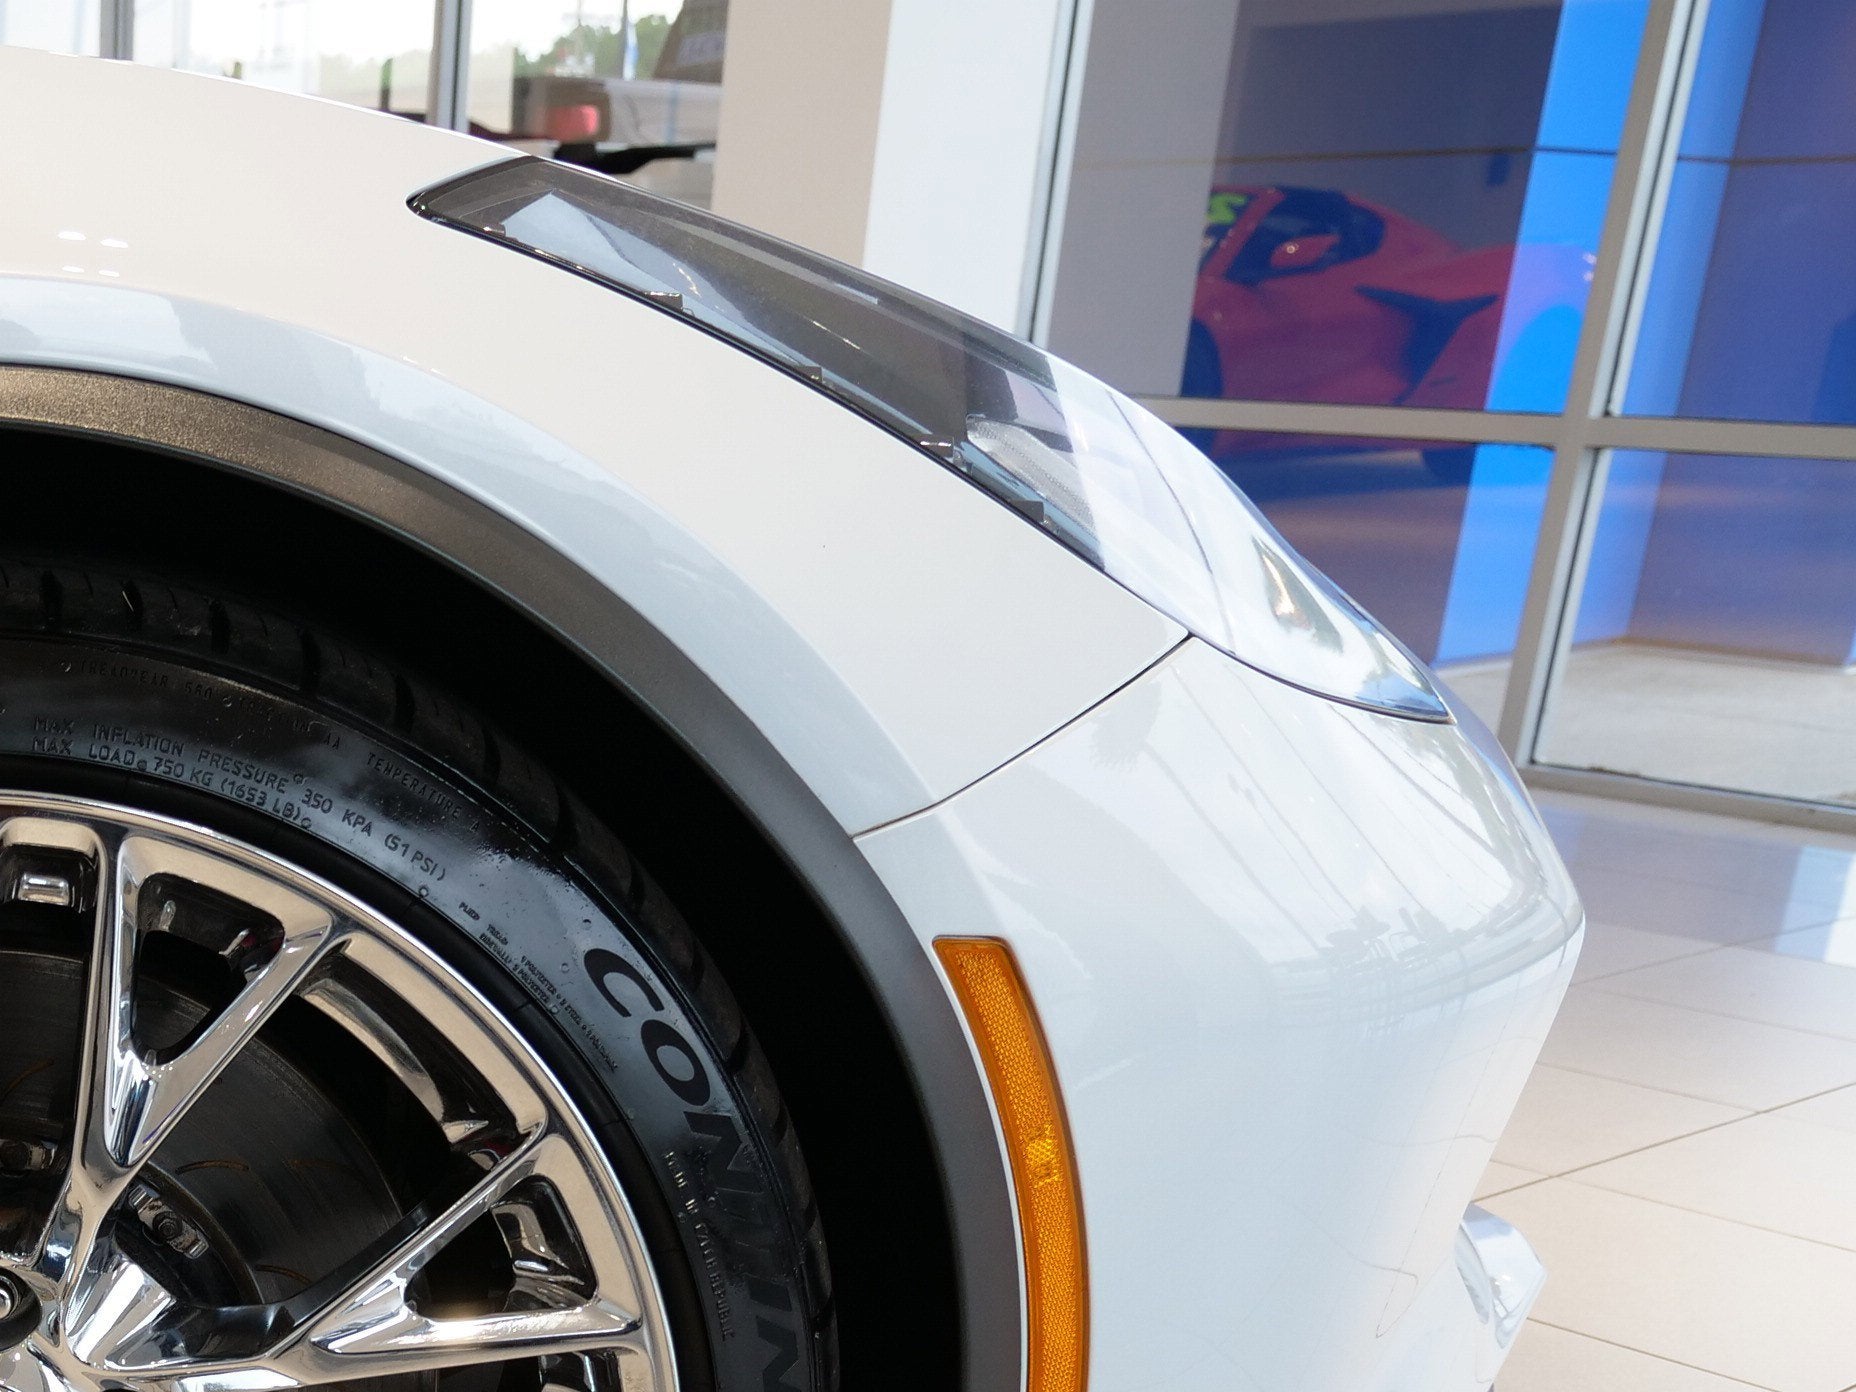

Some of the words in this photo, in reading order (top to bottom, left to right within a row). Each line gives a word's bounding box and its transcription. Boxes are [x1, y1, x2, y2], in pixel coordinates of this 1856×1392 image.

[30, 733, 73, 758] MAX
[86, 741, 136, 770] LOAD
[150, 754, 187, 782] 750
[188, 764, 215, 790] KG
[32, 714, 75, 738] MAX
[90, 721, 185, 761] INFLATION
[195, 745, 290, 796] PRESSURE
[300, 785, 335, 817] 350
[339, 805, 376, 839] KPA
